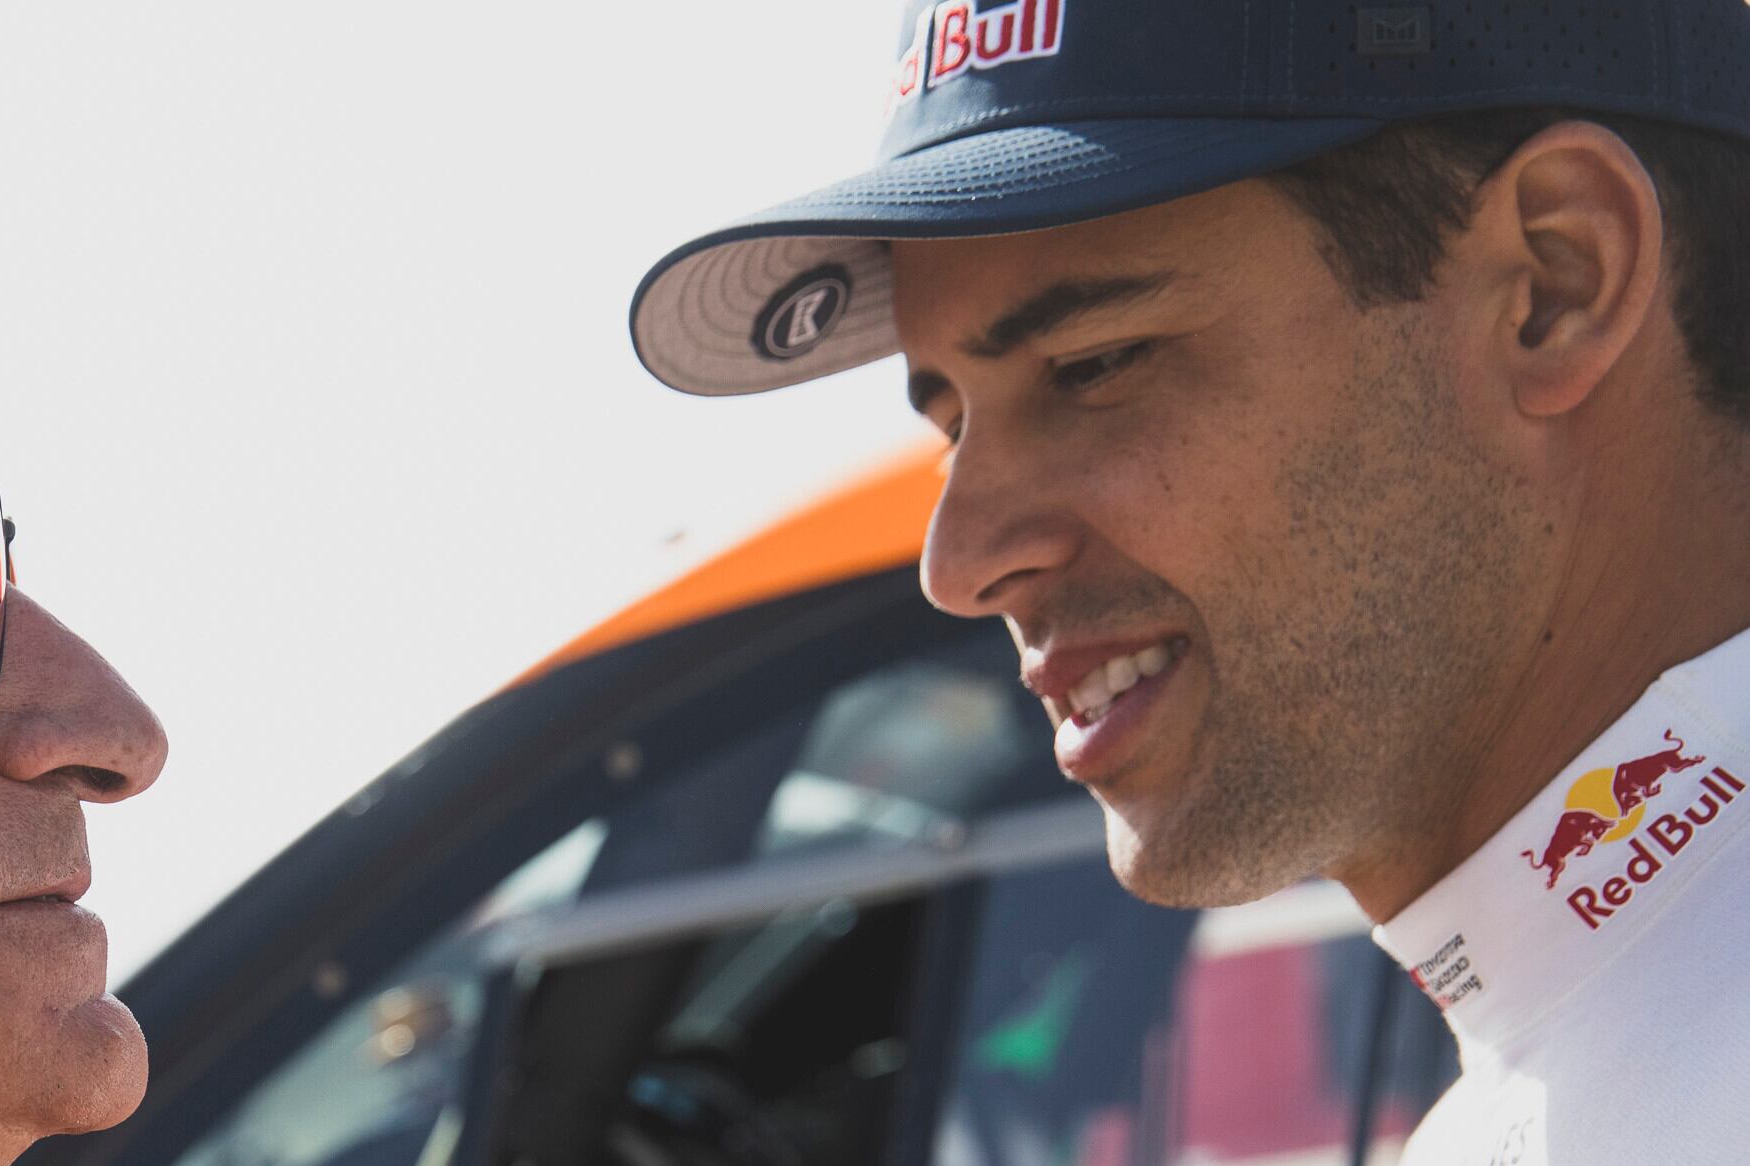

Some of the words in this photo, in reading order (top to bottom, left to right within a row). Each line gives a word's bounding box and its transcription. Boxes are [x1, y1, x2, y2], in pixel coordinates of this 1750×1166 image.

[934, 0, 1061, 79] Bull
[1566, 837, 1663, 931] Red
[1646, 766, 1747, 857] Bull
